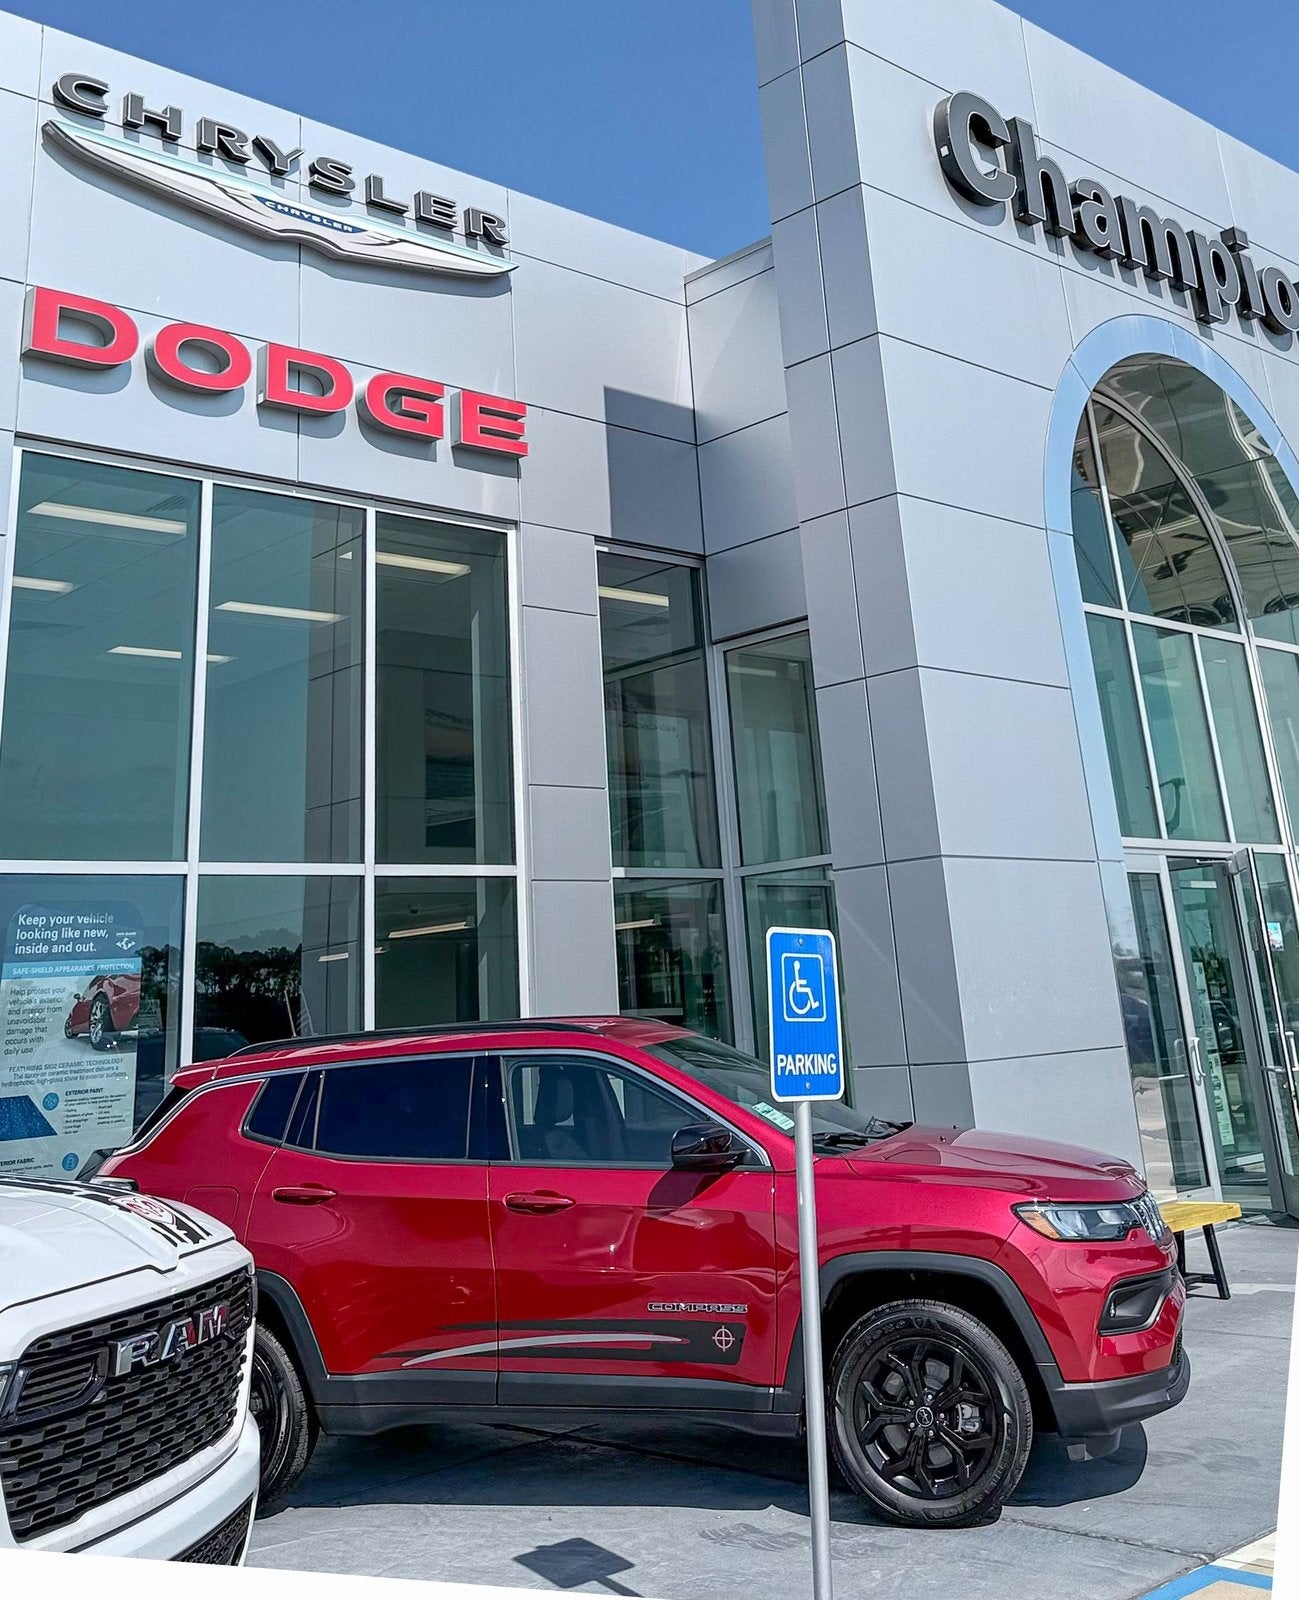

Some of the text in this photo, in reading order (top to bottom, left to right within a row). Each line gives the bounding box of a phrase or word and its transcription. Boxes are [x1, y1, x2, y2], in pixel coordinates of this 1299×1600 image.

[53, 73, 509, 246] CHRYSLER
[264, 200, 353, 233] CHRYSLER
[933, 90, 1299, 335] Champio
[21, 285, 530, 458] DODGE
[18, 912, 114, 927] Keep your vehicle
[15, 941, 97, 955] inside and out.
[16, 928, 59, 942] looking
[61, 927, 81, 939] like
[83, 929, 109, 939] new,
[777, 1053, 837, 1076] PARKING
[647, 1302, 749, 1314] COMPASS
[114, 1302, 228, 1377] RAM
